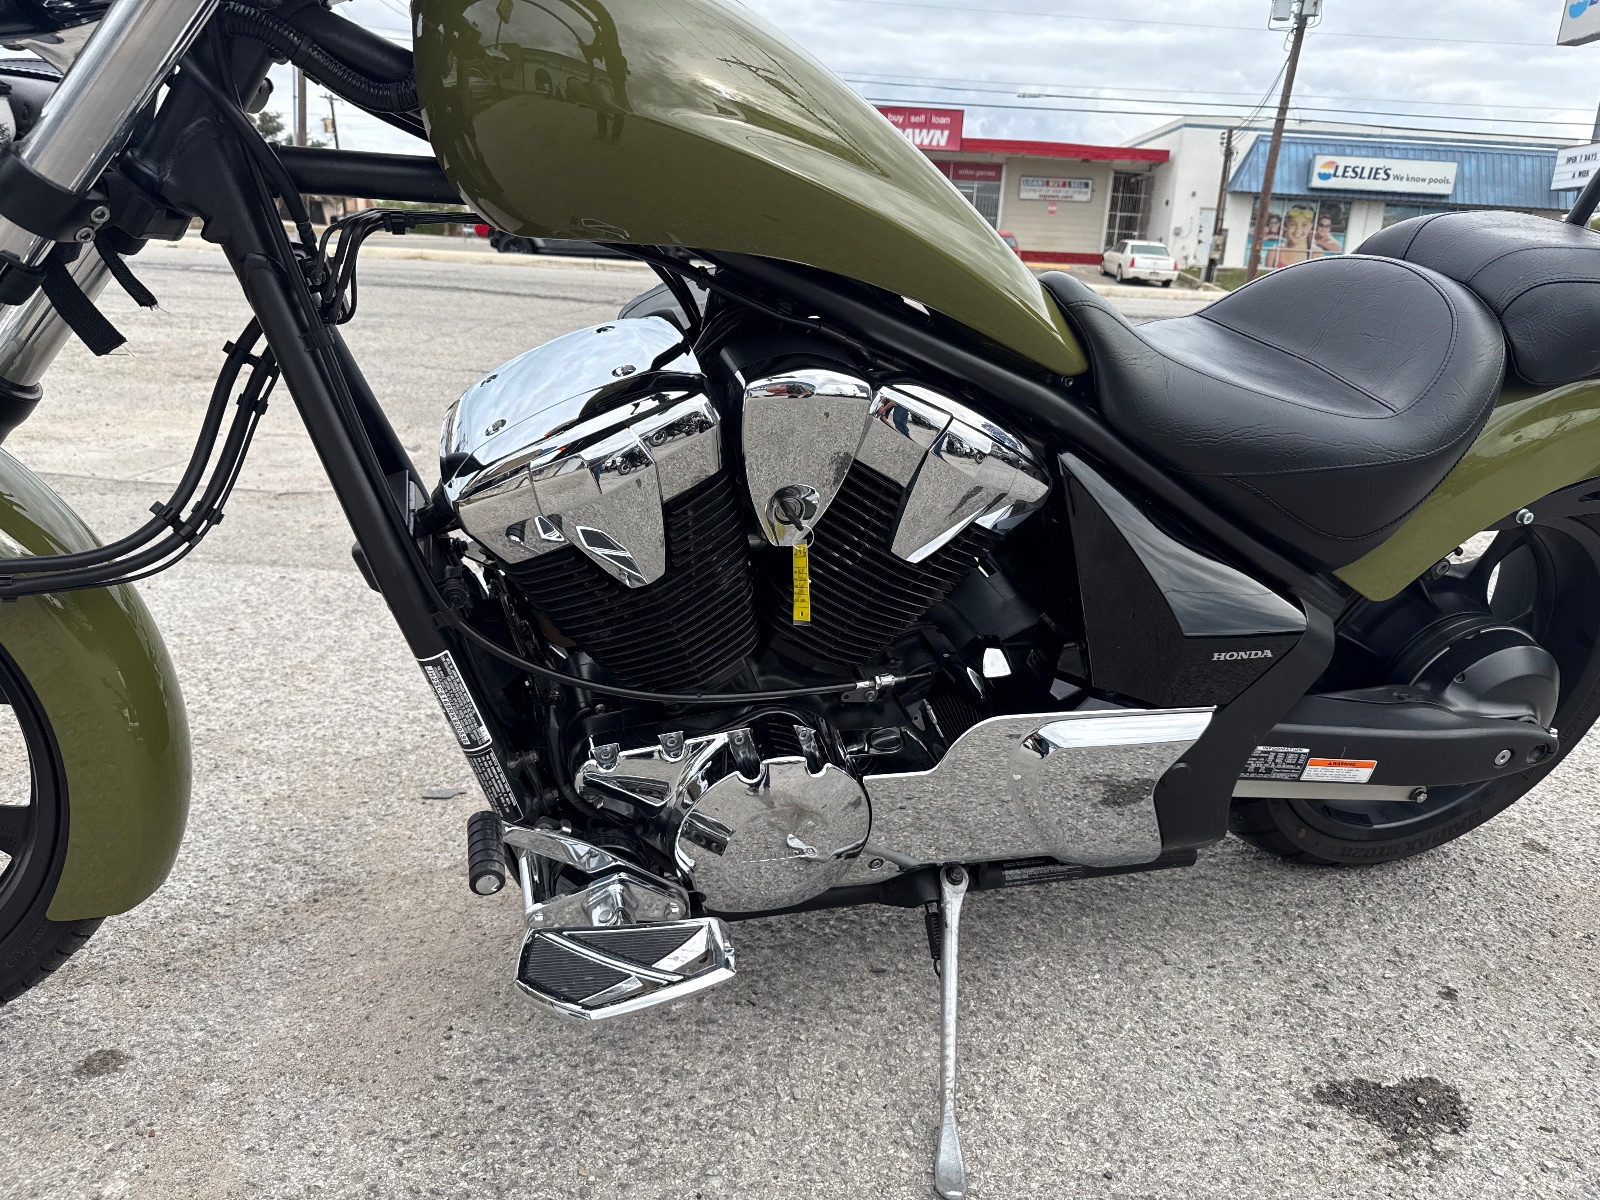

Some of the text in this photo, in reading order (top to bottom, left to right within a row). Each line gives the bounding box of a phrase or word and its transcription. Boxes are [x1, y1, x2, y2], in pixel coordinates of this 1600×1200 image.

[888, 113, 951, 124] buy sell loan
[898, 128, 950, 146] AWN
[1566, 155, 1577, 164] OPEN
[1584, 153, 1598, 161] DAYS
[1332, 164, 1392, 181] LESLIE'S
[1392, 173, 1405, 182] We
[1405, 174, 1427, 183] know
[1578, 170, 1590, 178] WEEK
[1212, 649, 1273, 661] HONDA
